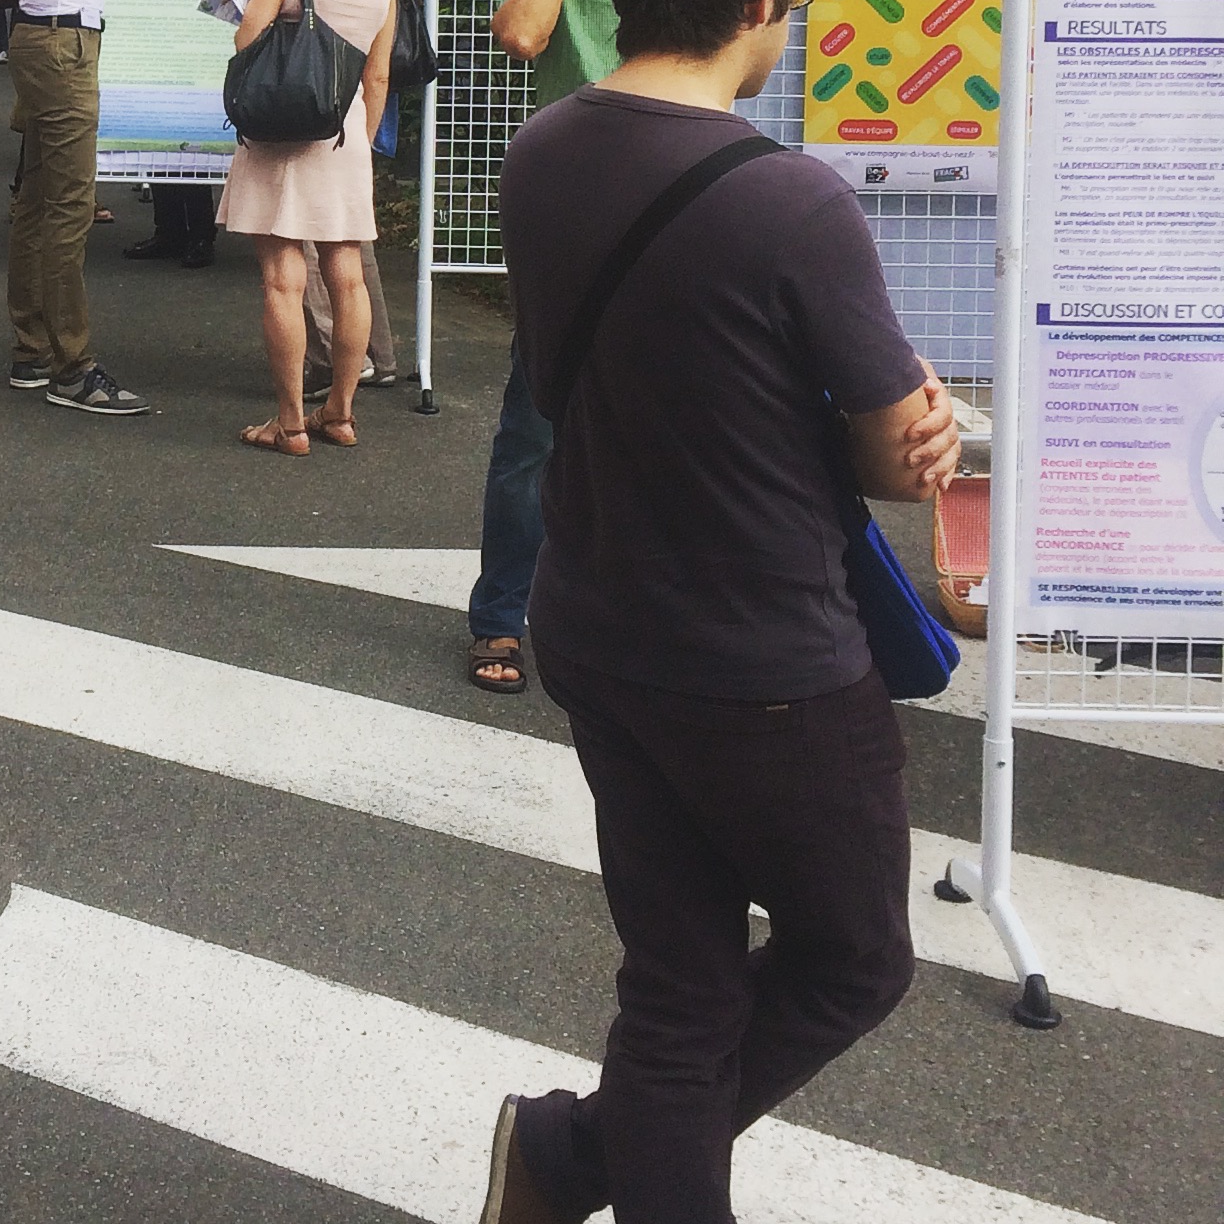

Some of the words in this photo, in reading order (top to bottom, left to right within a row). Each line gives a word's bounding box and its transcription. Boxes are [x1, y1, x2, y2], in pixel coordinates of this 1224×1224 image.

[1067, 20, 1167, 36] RESULTATS
[1057, 47, 1077, 57] LES
[1079, 47, 1141, 56] OBSTACLES
[1143, 47, 1153, 56] A
[1154, 47, 1168, 56] LA
[1061, 303, 1169, 318] DISCUSSION
[1175, 304, 1197, 318] ET
[1049, 332, 1061, 340] Le
[1062, 332, 1137, 342] développement
[1139, 333, 1156, 342] des
[1056, 350, 1141, 362] Déprescription
[1049, 368, 1136, 379] NOTIFICATION
[1045, 401, 1139, 412] COORDINATION
[1045, 438, 1080, 448] SUIVI
[1083, 440, 1097, 448] en
[1100, 439, 1171, 449] consultation
[1040, 458, 1082, 468] Recueil
[1085, 459, 1135, 470] explicite
[1138, 460, 1157, 469] des
[1040, 471, 1099, 481] ATTENTES
[1102, 472, 1116, 482] du
[1119, 473, 1161, 483] patient
[1036, 527, 1096, 538] Recherche
[1099, 529, 1131, 538] d'une
[1035, 540, 1125, 551] CONCORDANCE
[1038, 583, 1049, 592] SE
[1052, 584, 1139, 594] RESPONSABILISER
[1153, 587, 1204, 597] développer
[1040, 594, 1053, 603] de
[1054, 595, 1103, 604] conscience
[1105, 596, 1117, 604] de
